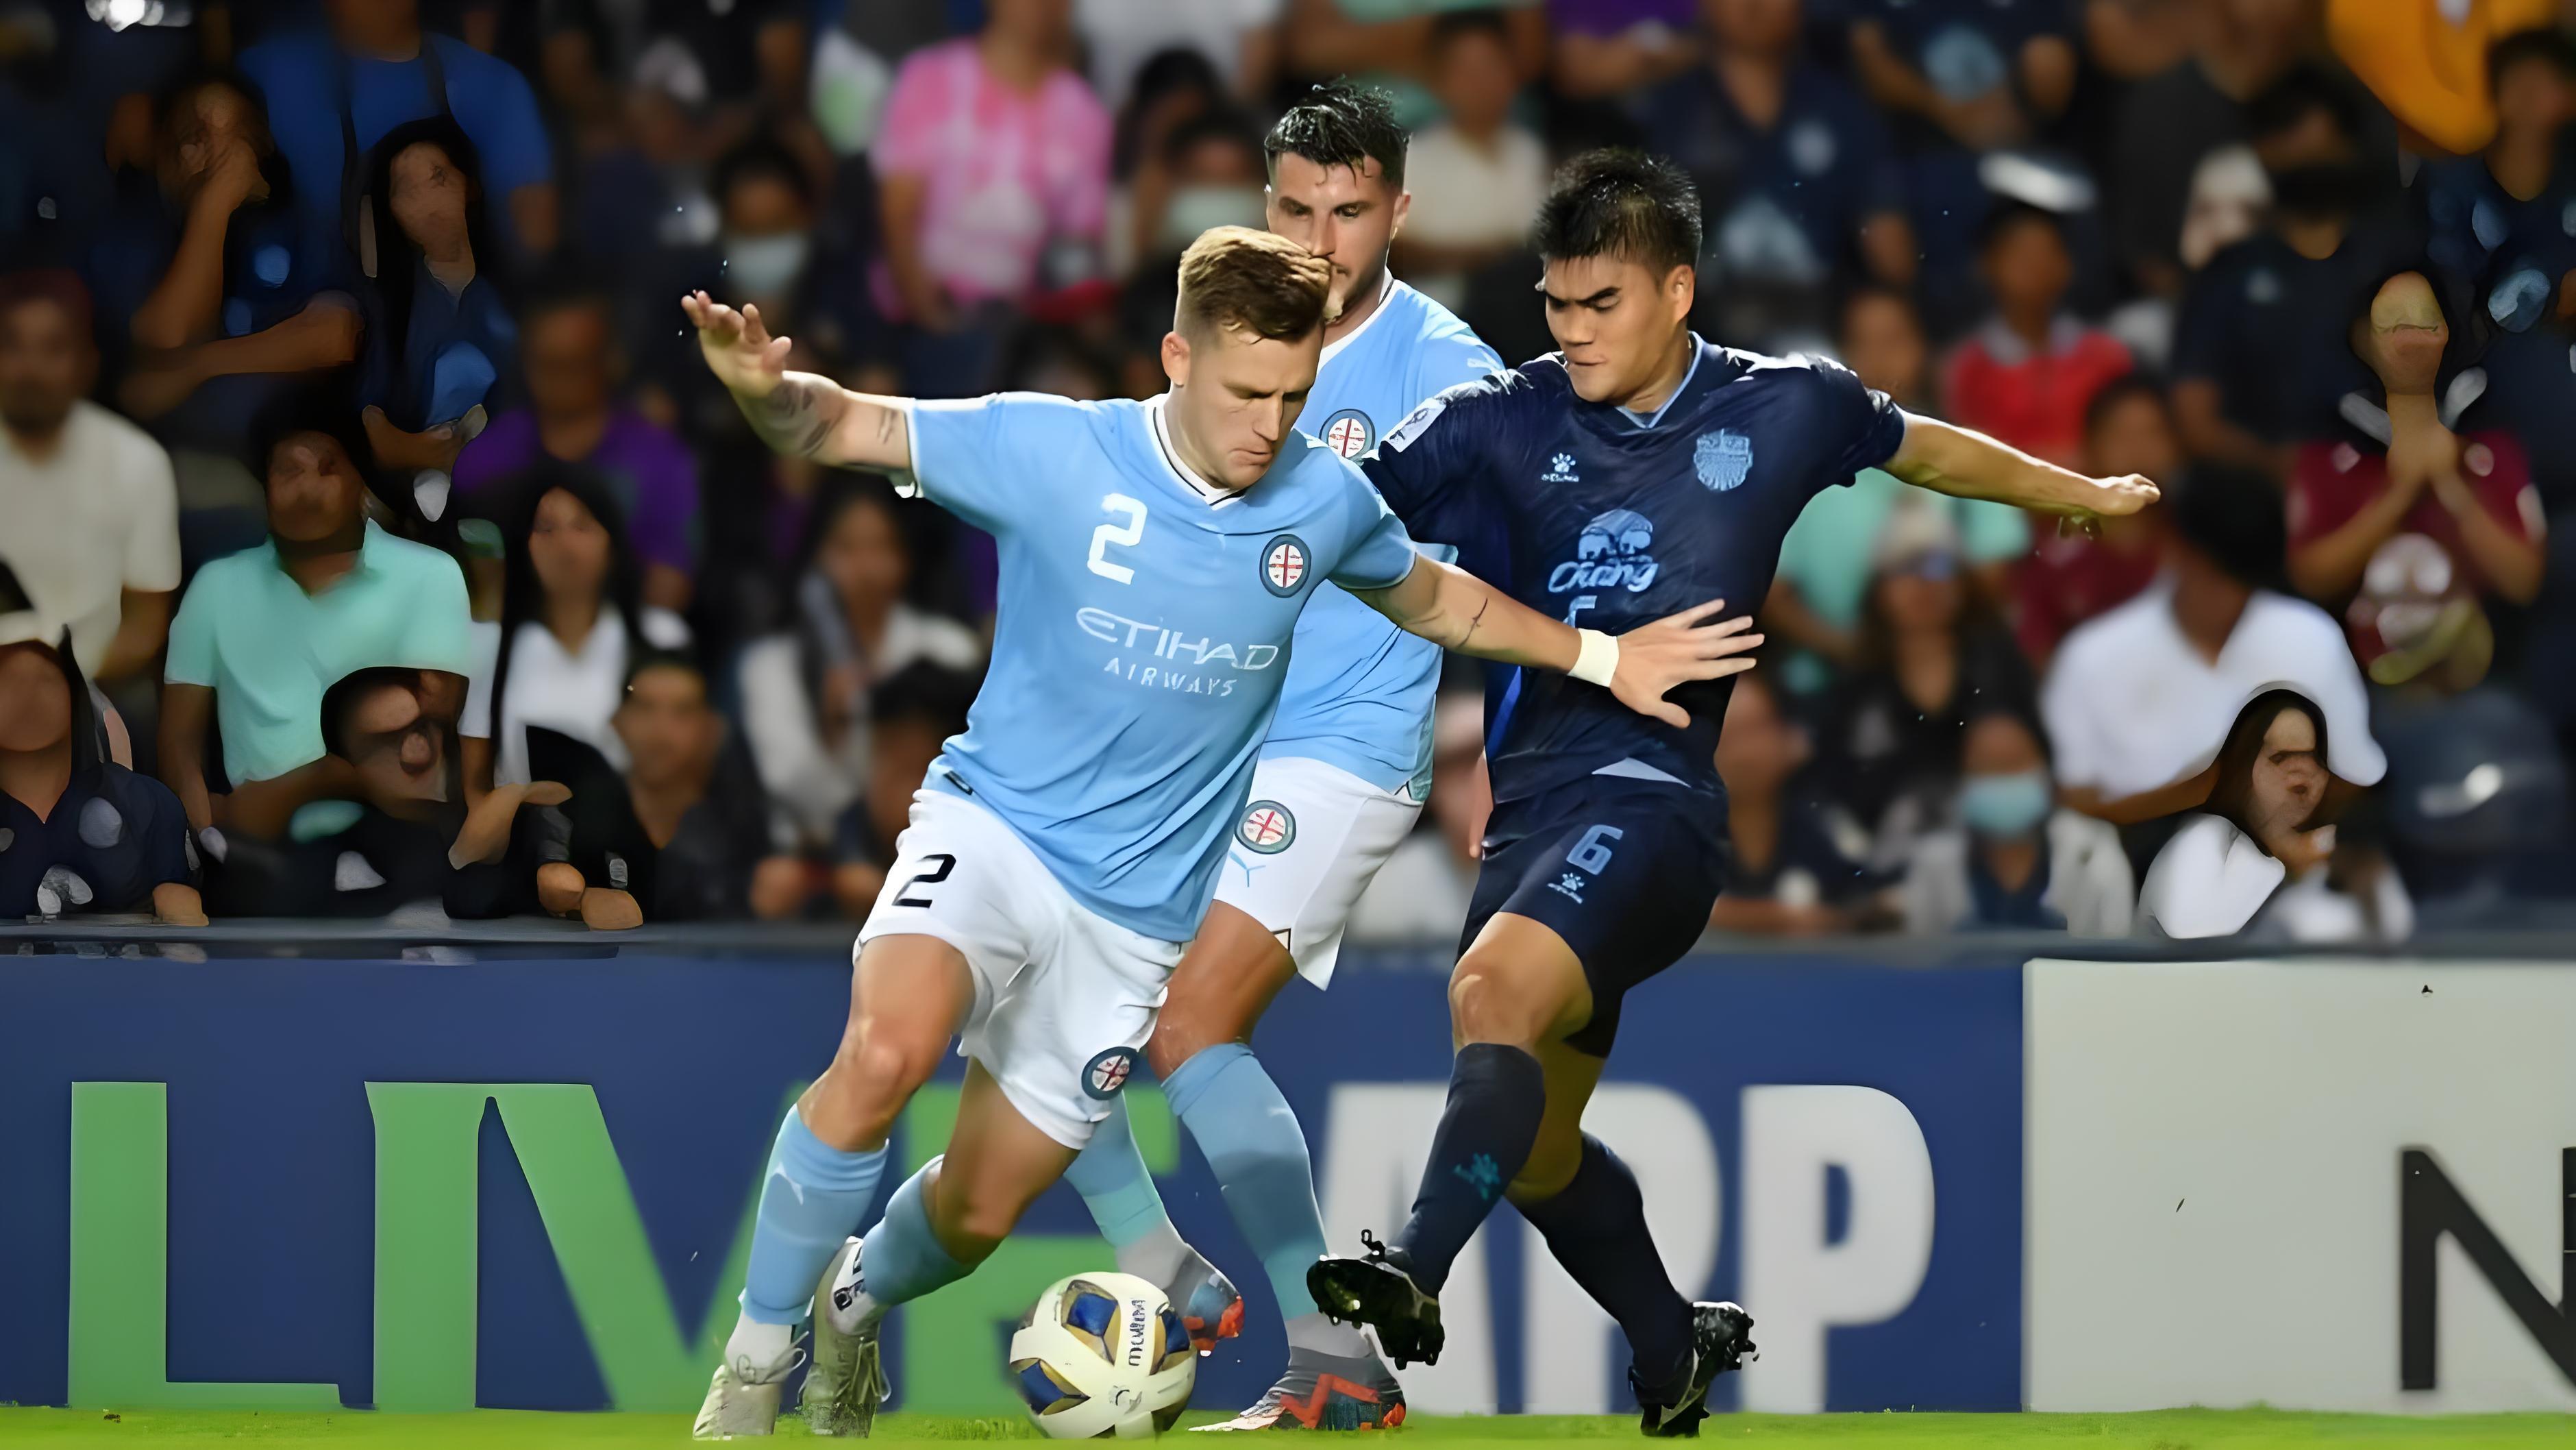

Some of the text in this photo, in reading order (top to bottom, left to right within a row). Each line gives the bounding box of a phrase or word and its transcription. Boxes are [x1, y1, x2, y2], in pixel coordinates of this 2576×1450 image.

[1087, 493, 1148, 585] 2
[1076, 606, 1279, 671] ETIHAD
[1104, 657, 1237, 697] AIRWAYS
[1565, 824, 1624, 876] 6
[891, 853, 957, 909] 2
[68, 1081, 1935, 1415] LIVE APP
